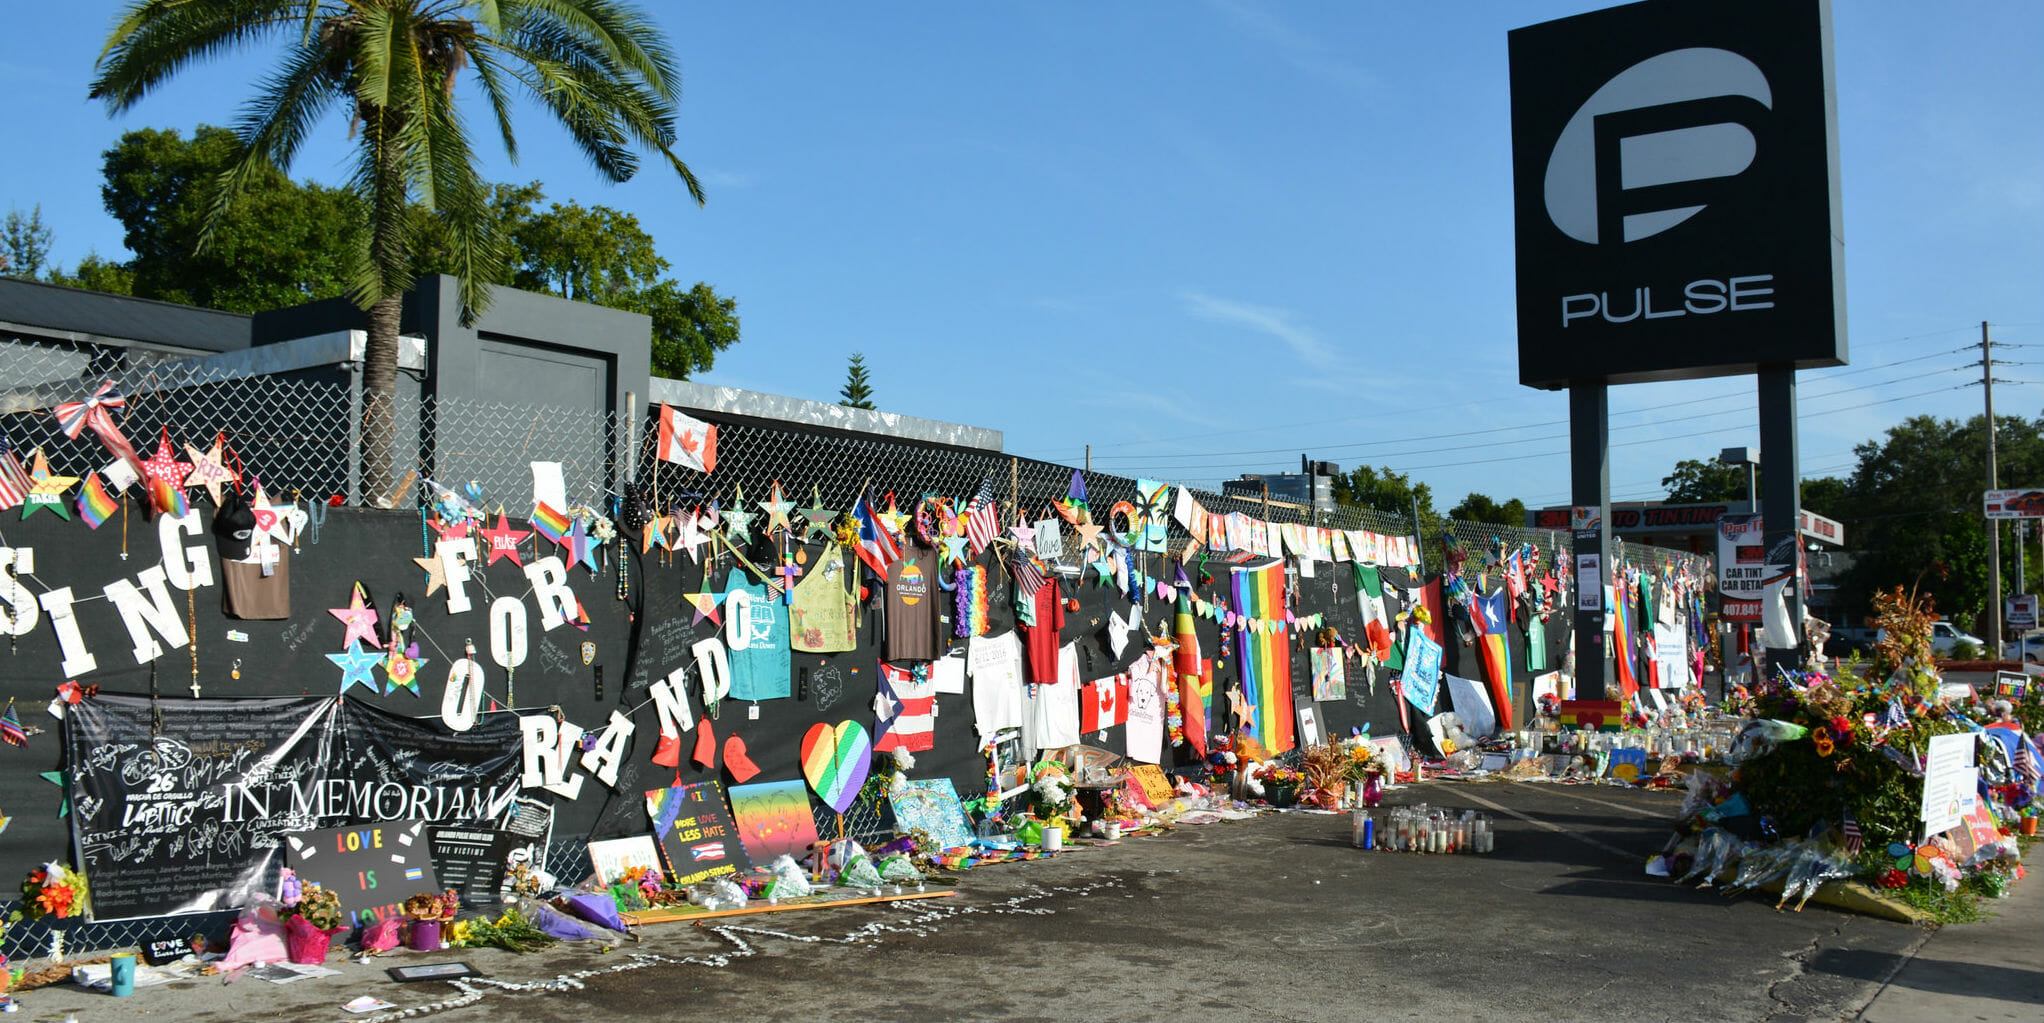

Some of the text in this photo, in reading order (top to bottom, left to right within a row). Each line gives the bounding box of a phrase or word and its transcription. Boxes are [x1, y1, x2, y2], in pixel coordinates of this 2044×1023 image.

[1562, 274, 1774, 328] PULSE
[155, 464, 171, 479] 49
[198, 457, 224, 482] RIP
[28, 493, 60, 505] TAKEN
[1540, 511, 1569, 527] 3M
[1644, 506, 1727, 526] TINTING
[1725, 522, 1747, 535] Pro
[1725, 567, 1742, 579] CAR
[896, 584, 926, 593] ORLANDO
[1721, 580, 1738, 591] CAR
[434, 537, 578, 668] FOR
[441, 588, 752, 800] ORLANDO
[1999, 684, 2025, 698] UNITED
[152, 793, 162, 801] DE
[221, 781, 273, 823] IN
[289, 778, 503, 822] MEMORIAM
[690, 790, 707, 802] RIP
[674, 812, 718, 829] MORE LOVE
[337, 828, 383, 853] LOVE
[678, 825, 726, 843] LESS HATE
[437, 845, 485, 857] THE VICTIMS
[358, 869, 378, 891] IS
[680, 863, 736, 885] ORLANDO STRONG
